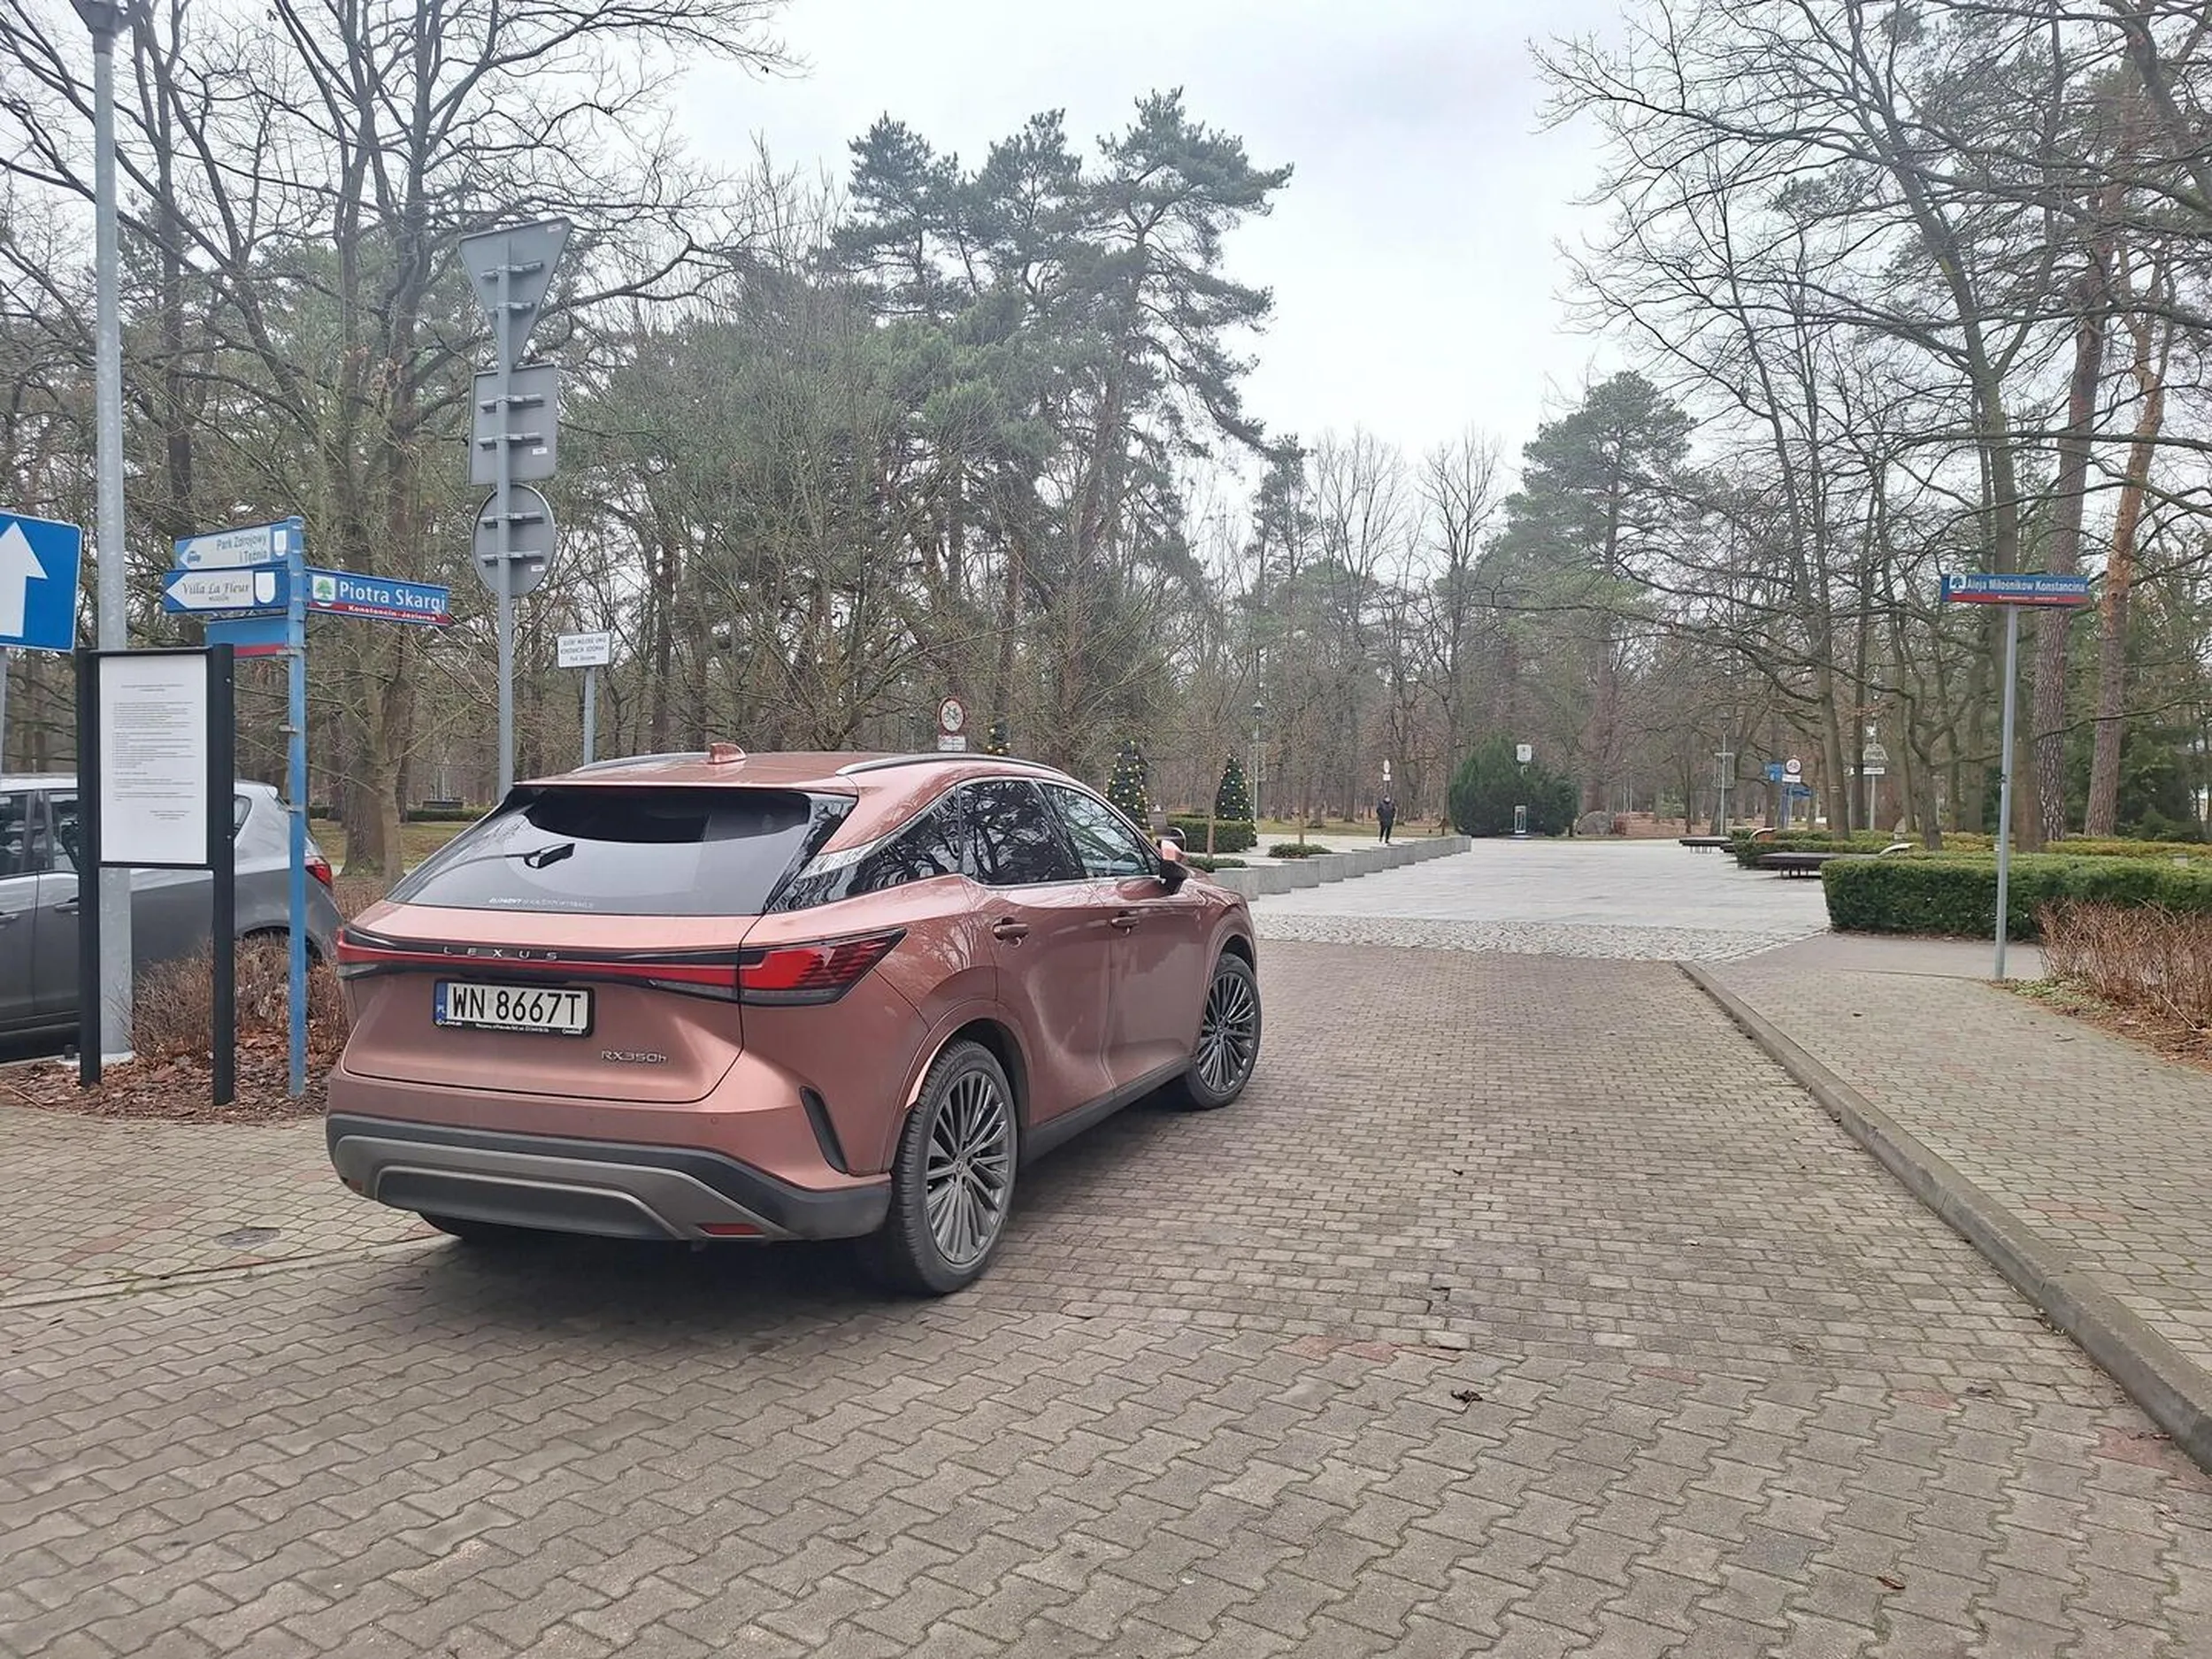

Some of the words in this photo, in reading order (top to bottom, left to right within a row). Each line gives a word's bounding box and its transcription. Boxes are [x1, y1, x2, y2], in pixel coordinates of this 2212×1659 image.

[182, 582, 205, 595] Villa
[209, 583, 220, 595] La
[225, 582, 249, 594] Fleur
[340, 580, 390, 604] Piotra
[396, 588, 446, 615] Skargi
[443, 946, 557, 961] LEXUS
[453, 986, 486, 1019] WN
[495, 989, 581, 1025] 8667T
[602, 1049, 667, 1063] RX350h
